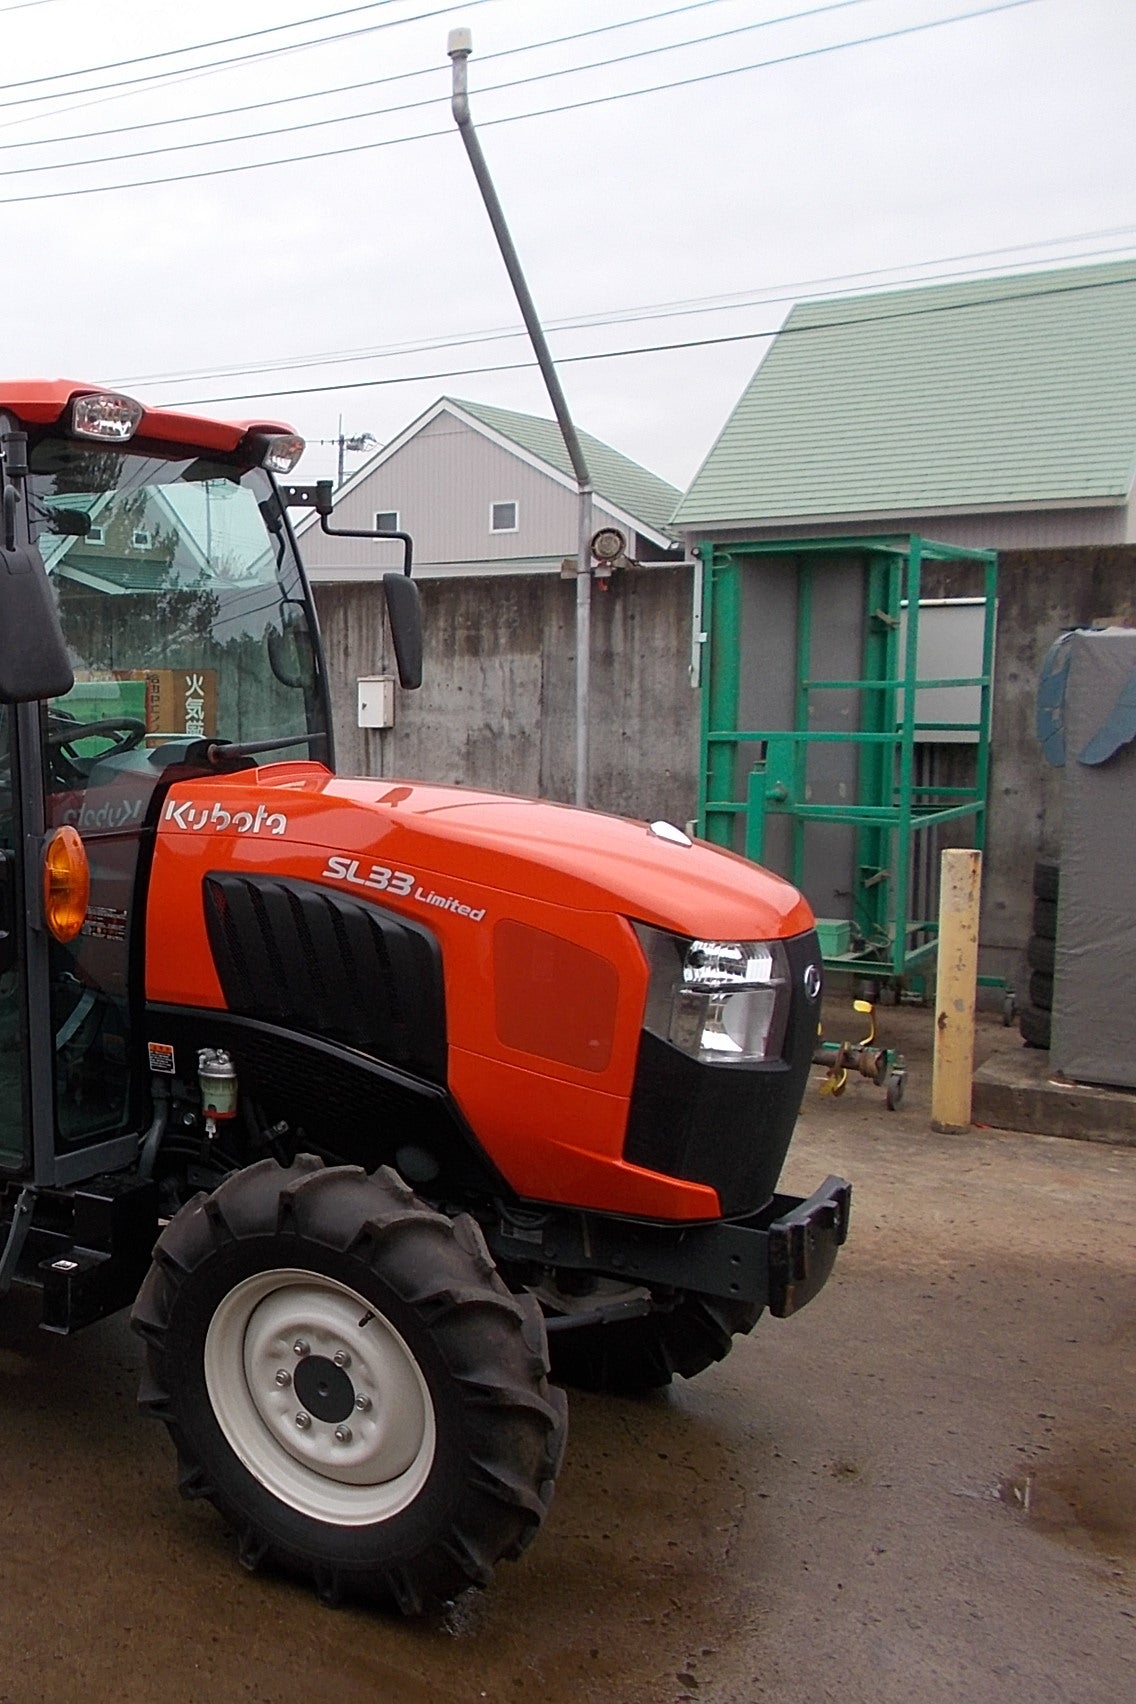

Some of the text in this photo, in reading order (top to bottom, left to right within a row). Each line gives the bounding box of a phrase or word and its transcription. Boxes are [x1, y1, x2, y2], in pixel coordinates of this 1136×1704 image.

[165, 800, 287, 836] Kubota
[322, 856, 486, 922] SL33 Limited
